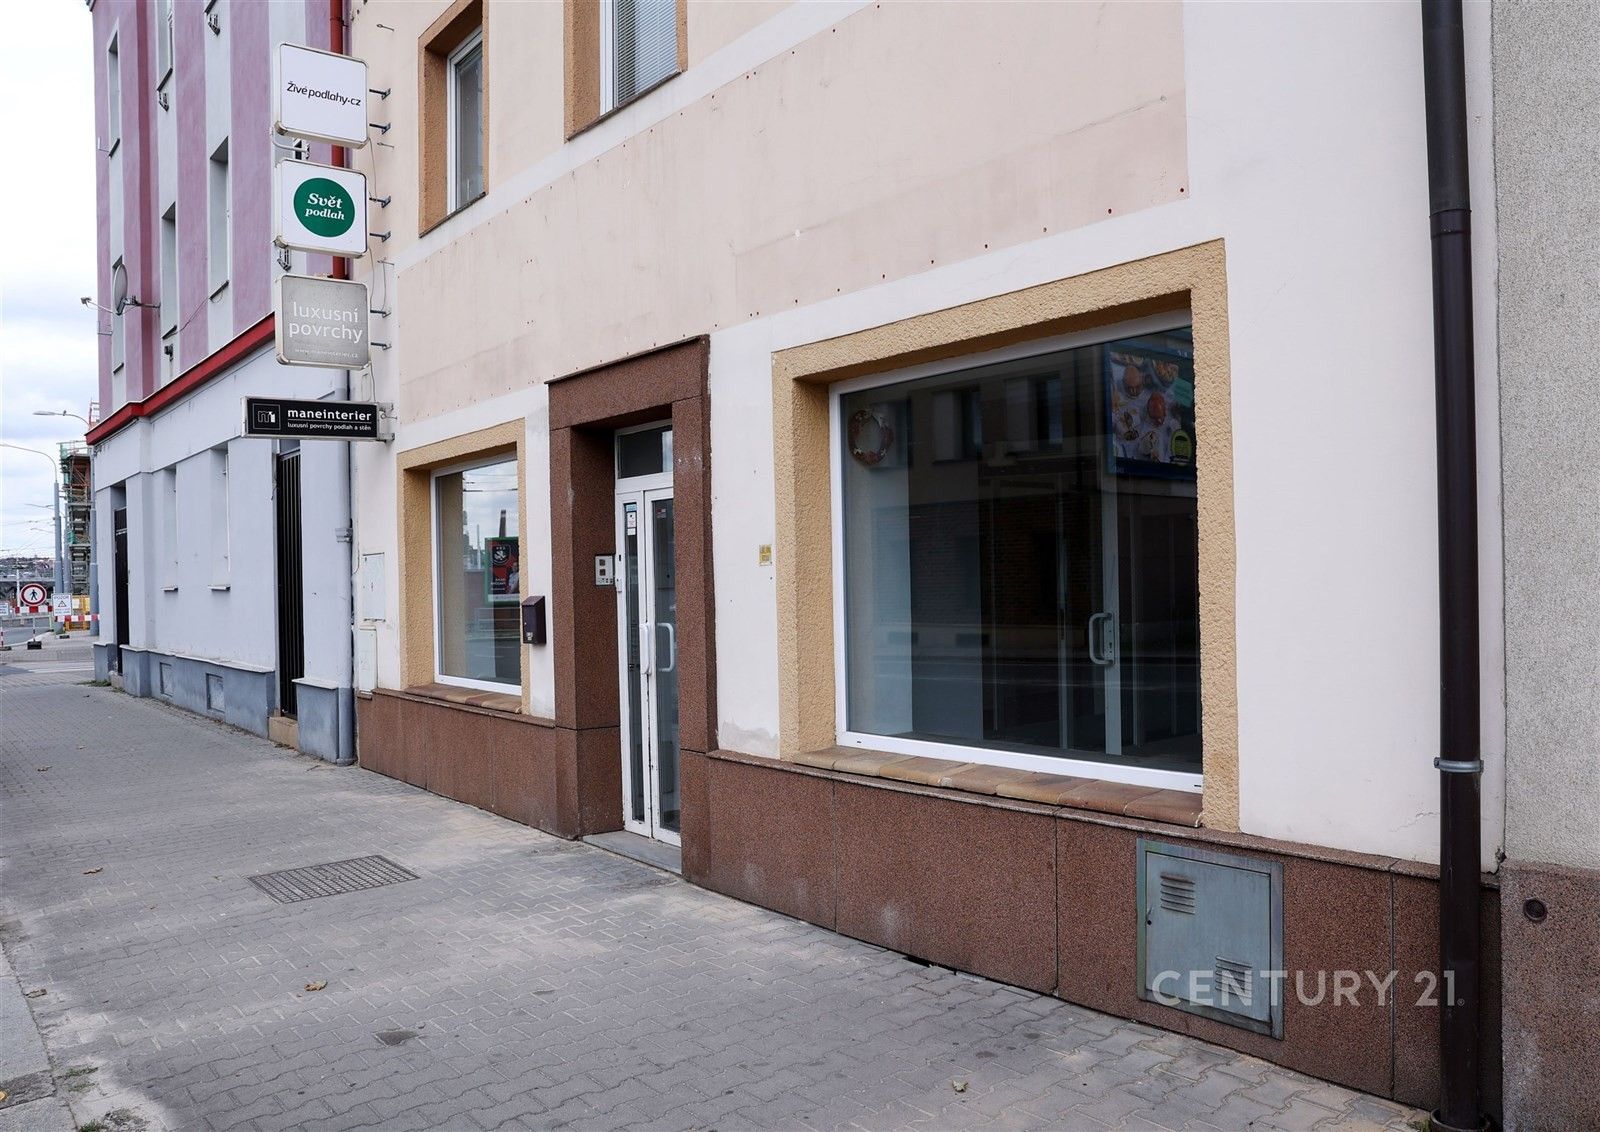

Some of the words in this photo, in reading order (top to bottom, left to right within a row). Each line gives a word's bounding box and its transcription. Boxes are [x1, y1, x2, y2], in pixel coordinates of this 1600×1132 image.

[307, 192, 343, 209] Svět
[305, 208, 345, 220] podlah
[293, 301, 359, 323] luxusní
[288, 322, 363, 344] povrchy
[287, 409, 372, 421] maneinterier
[287, 421, 309, 429] luxusní
[309, 423, 333, 431] povrchy
[333, 423, 353, 431] podlah
